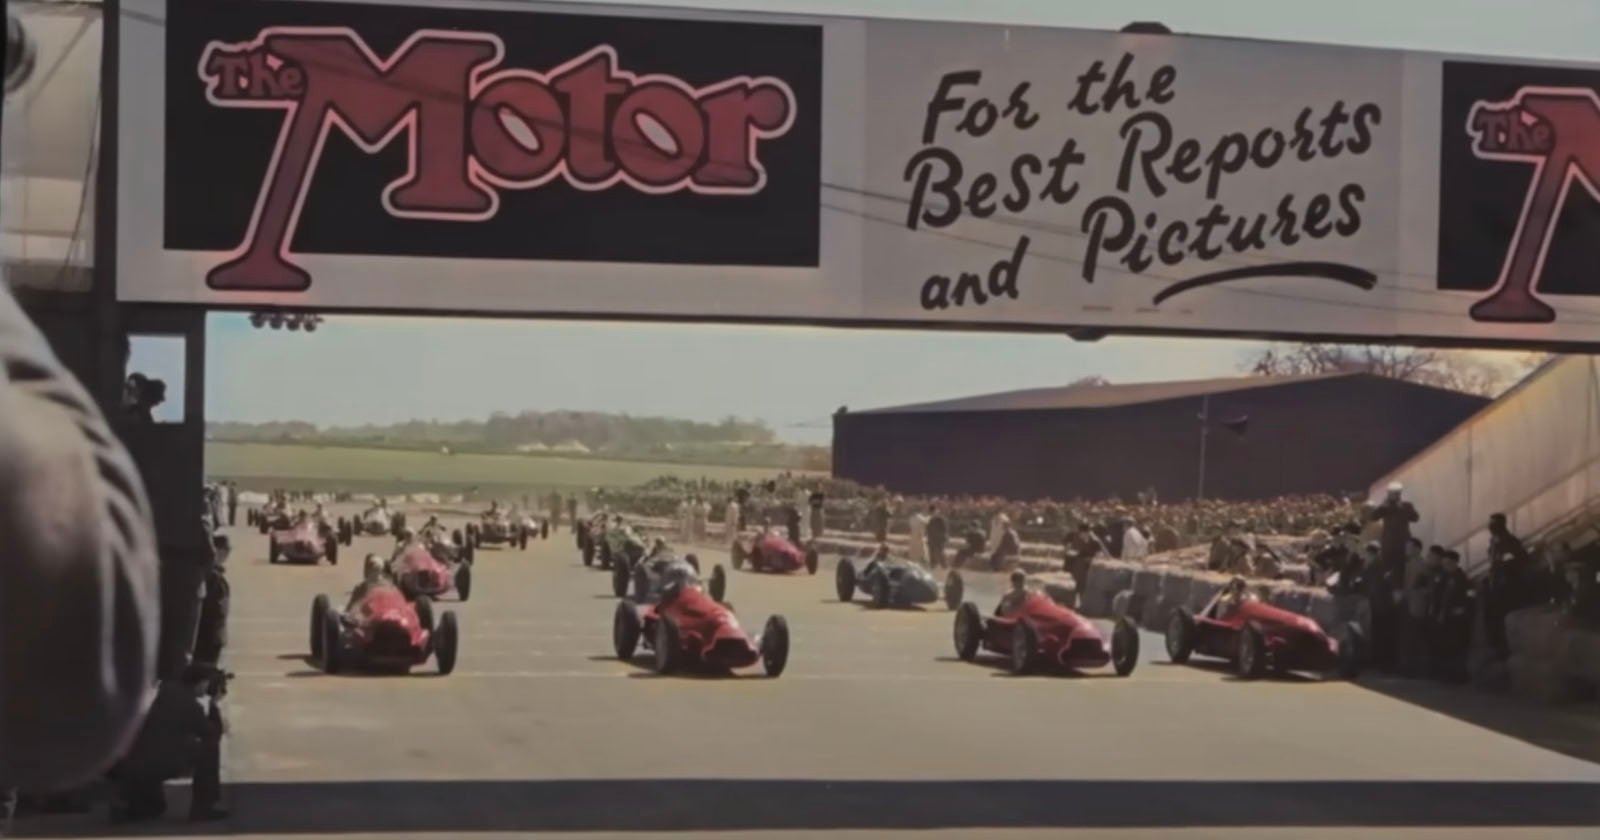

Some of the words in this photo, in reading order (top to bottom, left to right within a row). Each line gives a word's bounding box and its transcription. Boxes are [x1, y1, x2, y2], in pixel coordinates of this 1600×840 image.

[207, 47, 304, 99] The
[921, 69, 1041, 145] For
[1066, 52, 1178, 116] the
[205, 30, 792, 291] Motor
[903, 138, 1087, 231] Best
[1116, 99, 1383, 200] Reports
[1472, 107, 1554, 153] The
[919, 234, 1031, 310] and
[1080, 183, 1367, 284] Pictures
